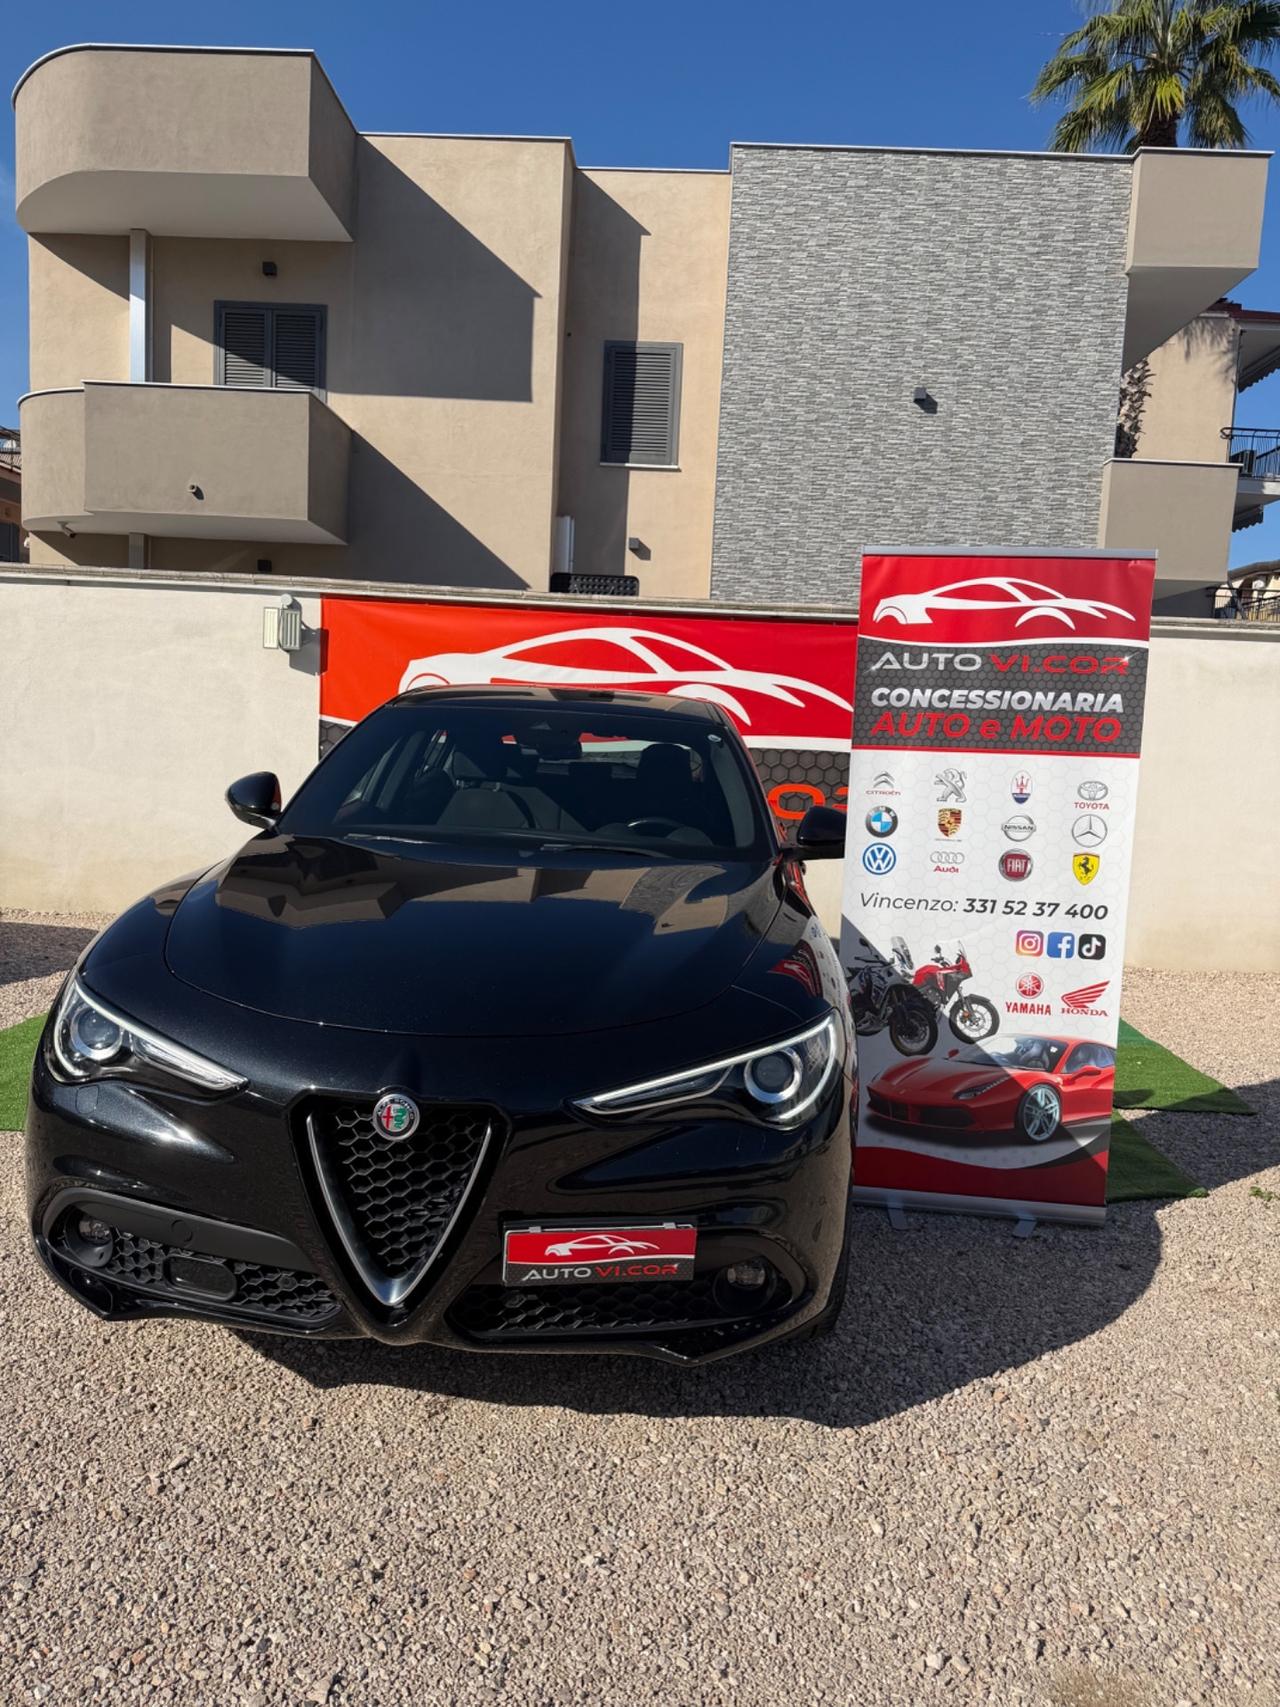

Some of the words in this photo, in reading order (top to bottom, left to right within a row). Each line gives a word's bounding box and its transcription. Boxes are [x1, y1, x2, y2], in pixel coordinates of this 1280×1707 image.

[872, 651, 982, 671] AUTO
[989, 654, 1129, 675] VI.COR
[871, 687, 1124, 712] CONCESSIONARIA
[870, 711, 970, 738] AUTO
[979, 719, 1001, 739] e
[1010, 714, 1122, 743] MOTO
[1074, 801, 1110, 811] TOYOTA
[1007, 858, 1028, 873] FIAT
[860, 893, 959, 913] Vincenzo:
[963, 897, 997, 914] 331
[1002, 899, 1028, 916] 52
[1032, 901, 1060, 918] 37
[1064, 903, 1109, 920] 400
[1005, 1001, 1052, 1016] YAMAHA
[1061, 1007, 1109, 1018] HONDA
[520, 1267, 592, 1282] AUTO
[594, 1263, 678, 1278] VI.COR
